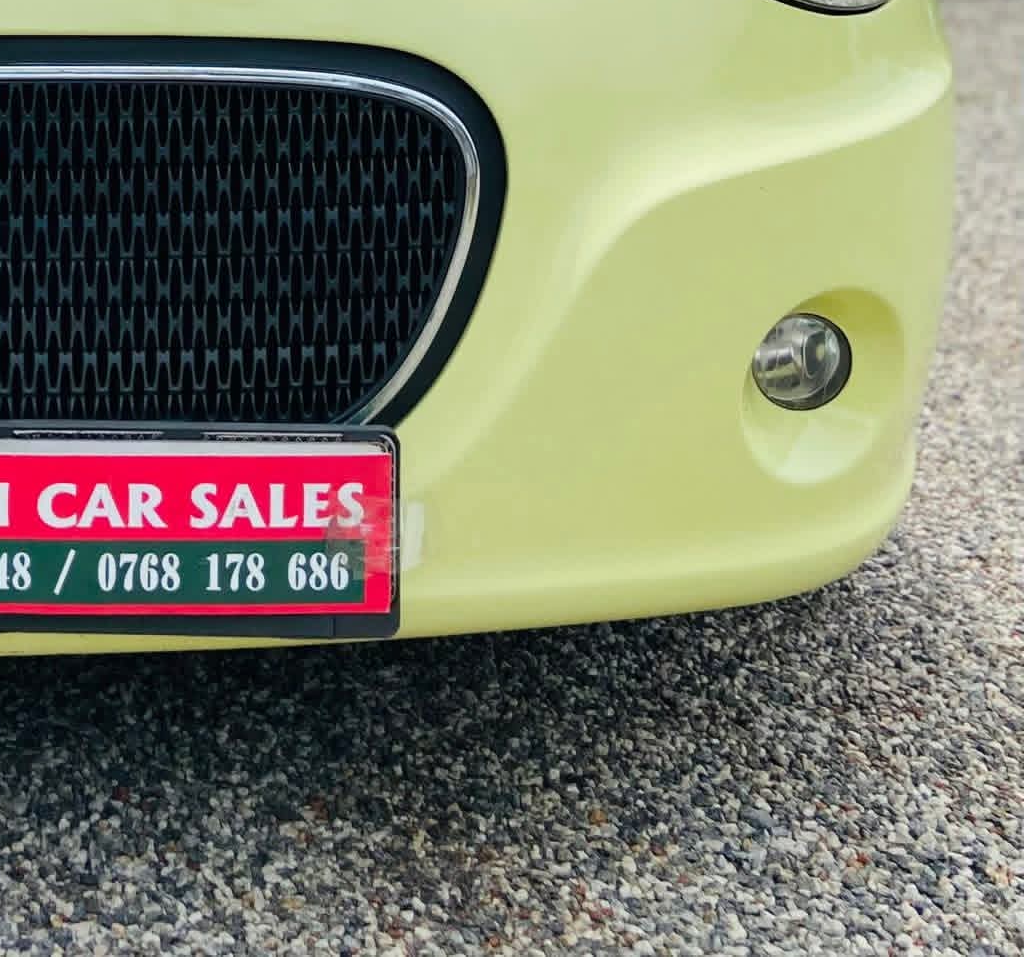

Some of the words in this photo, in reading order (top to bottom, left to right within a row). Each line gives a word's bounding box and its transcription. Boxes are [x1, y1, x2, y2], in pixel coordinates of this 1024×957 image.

[36, 482, 168, 529] CAR
[189, 482, 365, 529] SALES
[53, 548, 76, 595] /
[97, 552, 181, 592] 0768
[204, 552, 266, 592] 178
[287, 551, 350, 592] 686
